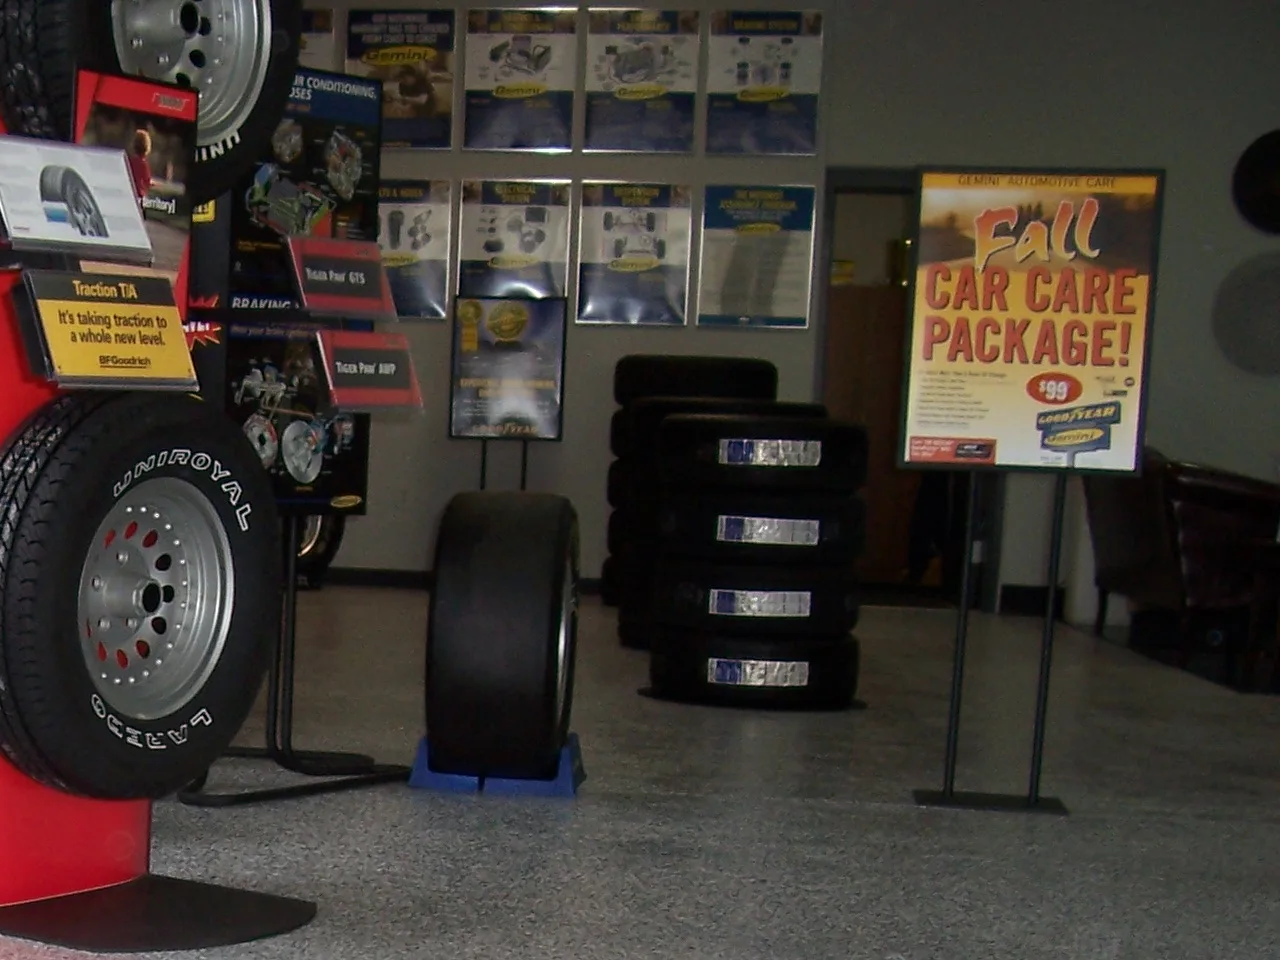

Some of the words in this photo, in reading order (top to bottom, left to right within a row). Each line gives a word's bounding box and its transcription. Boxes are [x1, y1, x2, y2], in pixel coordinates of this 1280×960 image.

[974, 198, 1101, 272] Fall
[72, 280, 118, 297] Traction
[925, 263, 1010, 311] CAR
[1025, 266, 1139, 314] CARE
[70, 331, 77, 342] a
[79, 328, 112, 344] whole
[114, 334, 136, 345] new
[77, 311, 112, 329] taking
[113, 312, 154, 328] traction
[156, 315, 167, 329] to
[922, 315, 1132, 367] PACKAGE!
[1039, 380, 1069, 401] $99
[112, 448, 252, 532] UNIROYAL
[91, 694, 213, 750] LAREDO
